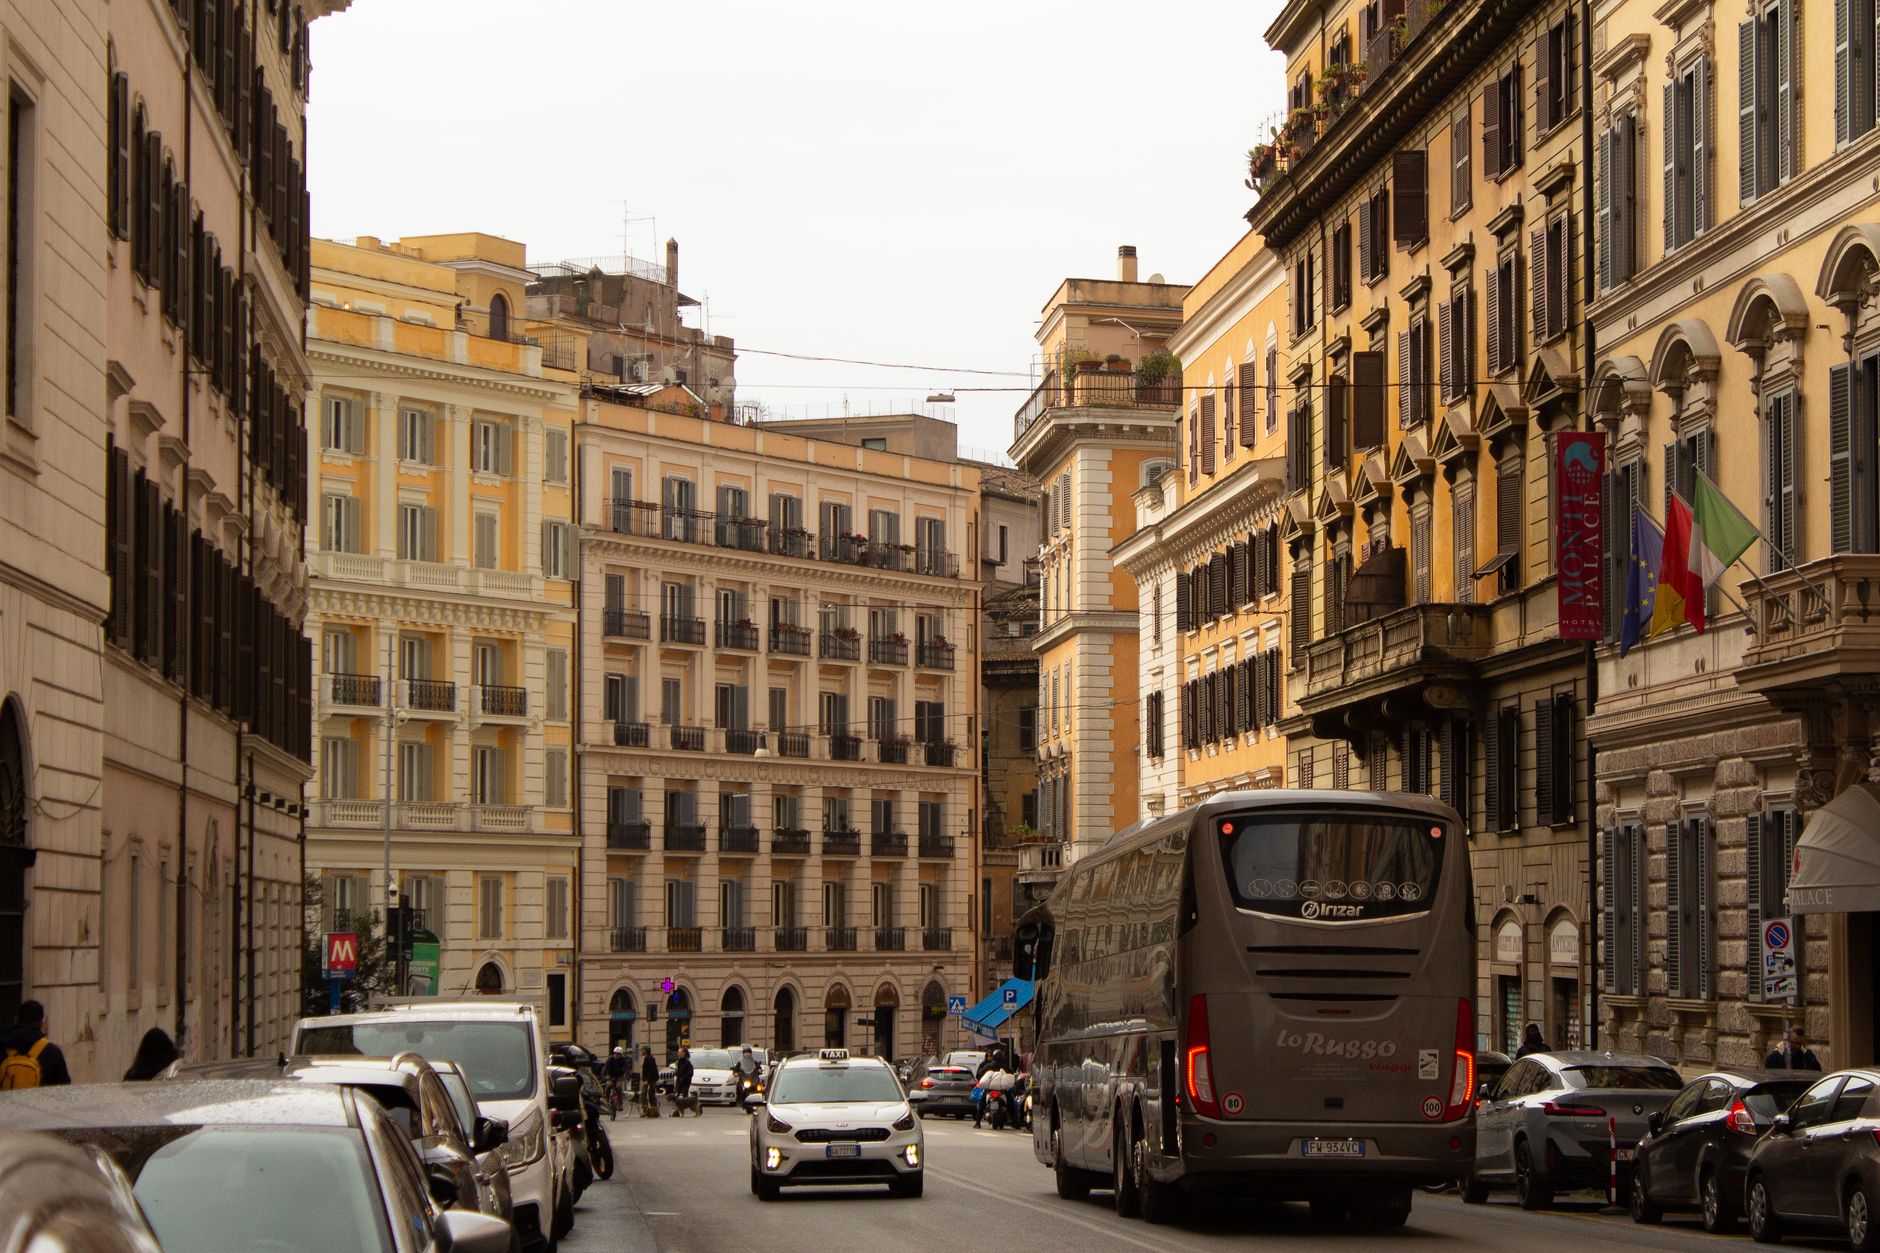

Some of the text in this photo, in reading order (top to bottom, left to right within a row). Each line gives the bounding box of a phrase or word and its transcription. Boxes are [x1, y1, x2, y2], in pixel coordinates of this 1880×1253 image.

[1562, 495, 1584, 606] MONTI
[1583, 492, 1600, 607] PALACE
[1320, 903, 1364, 917] Irizar
[331, 940, 355, 962] M
[1005, 991, 1014, 1001] P
[824, 1051, 845, 1059] TAXI
[1228, 1098, 1239, 1109] 80
[1425, 1102, 1440, 1113] 100
[1309, 1142, 1323, 1153] FW
